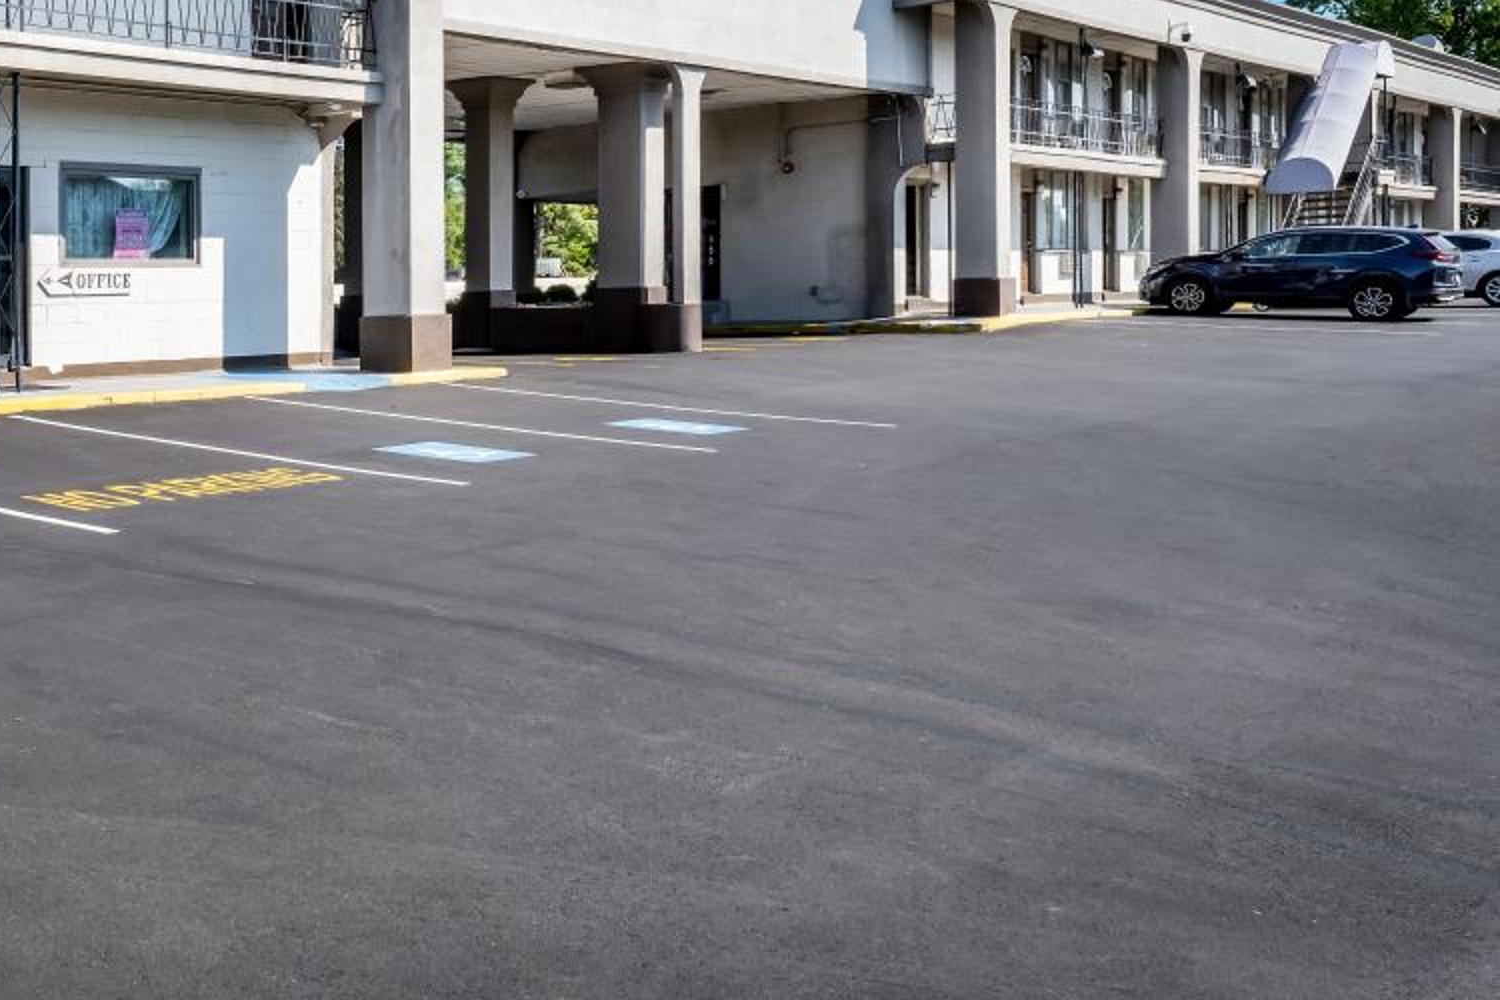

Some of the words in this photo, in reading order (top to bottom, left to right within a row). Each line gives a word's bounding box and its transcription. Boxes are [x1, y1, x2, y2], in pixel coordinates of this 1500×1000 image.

[76, 273, 131, 289] OFFICE
[20, 490, 140, 511] NO
[102, 467, 343, 501] PARKING
